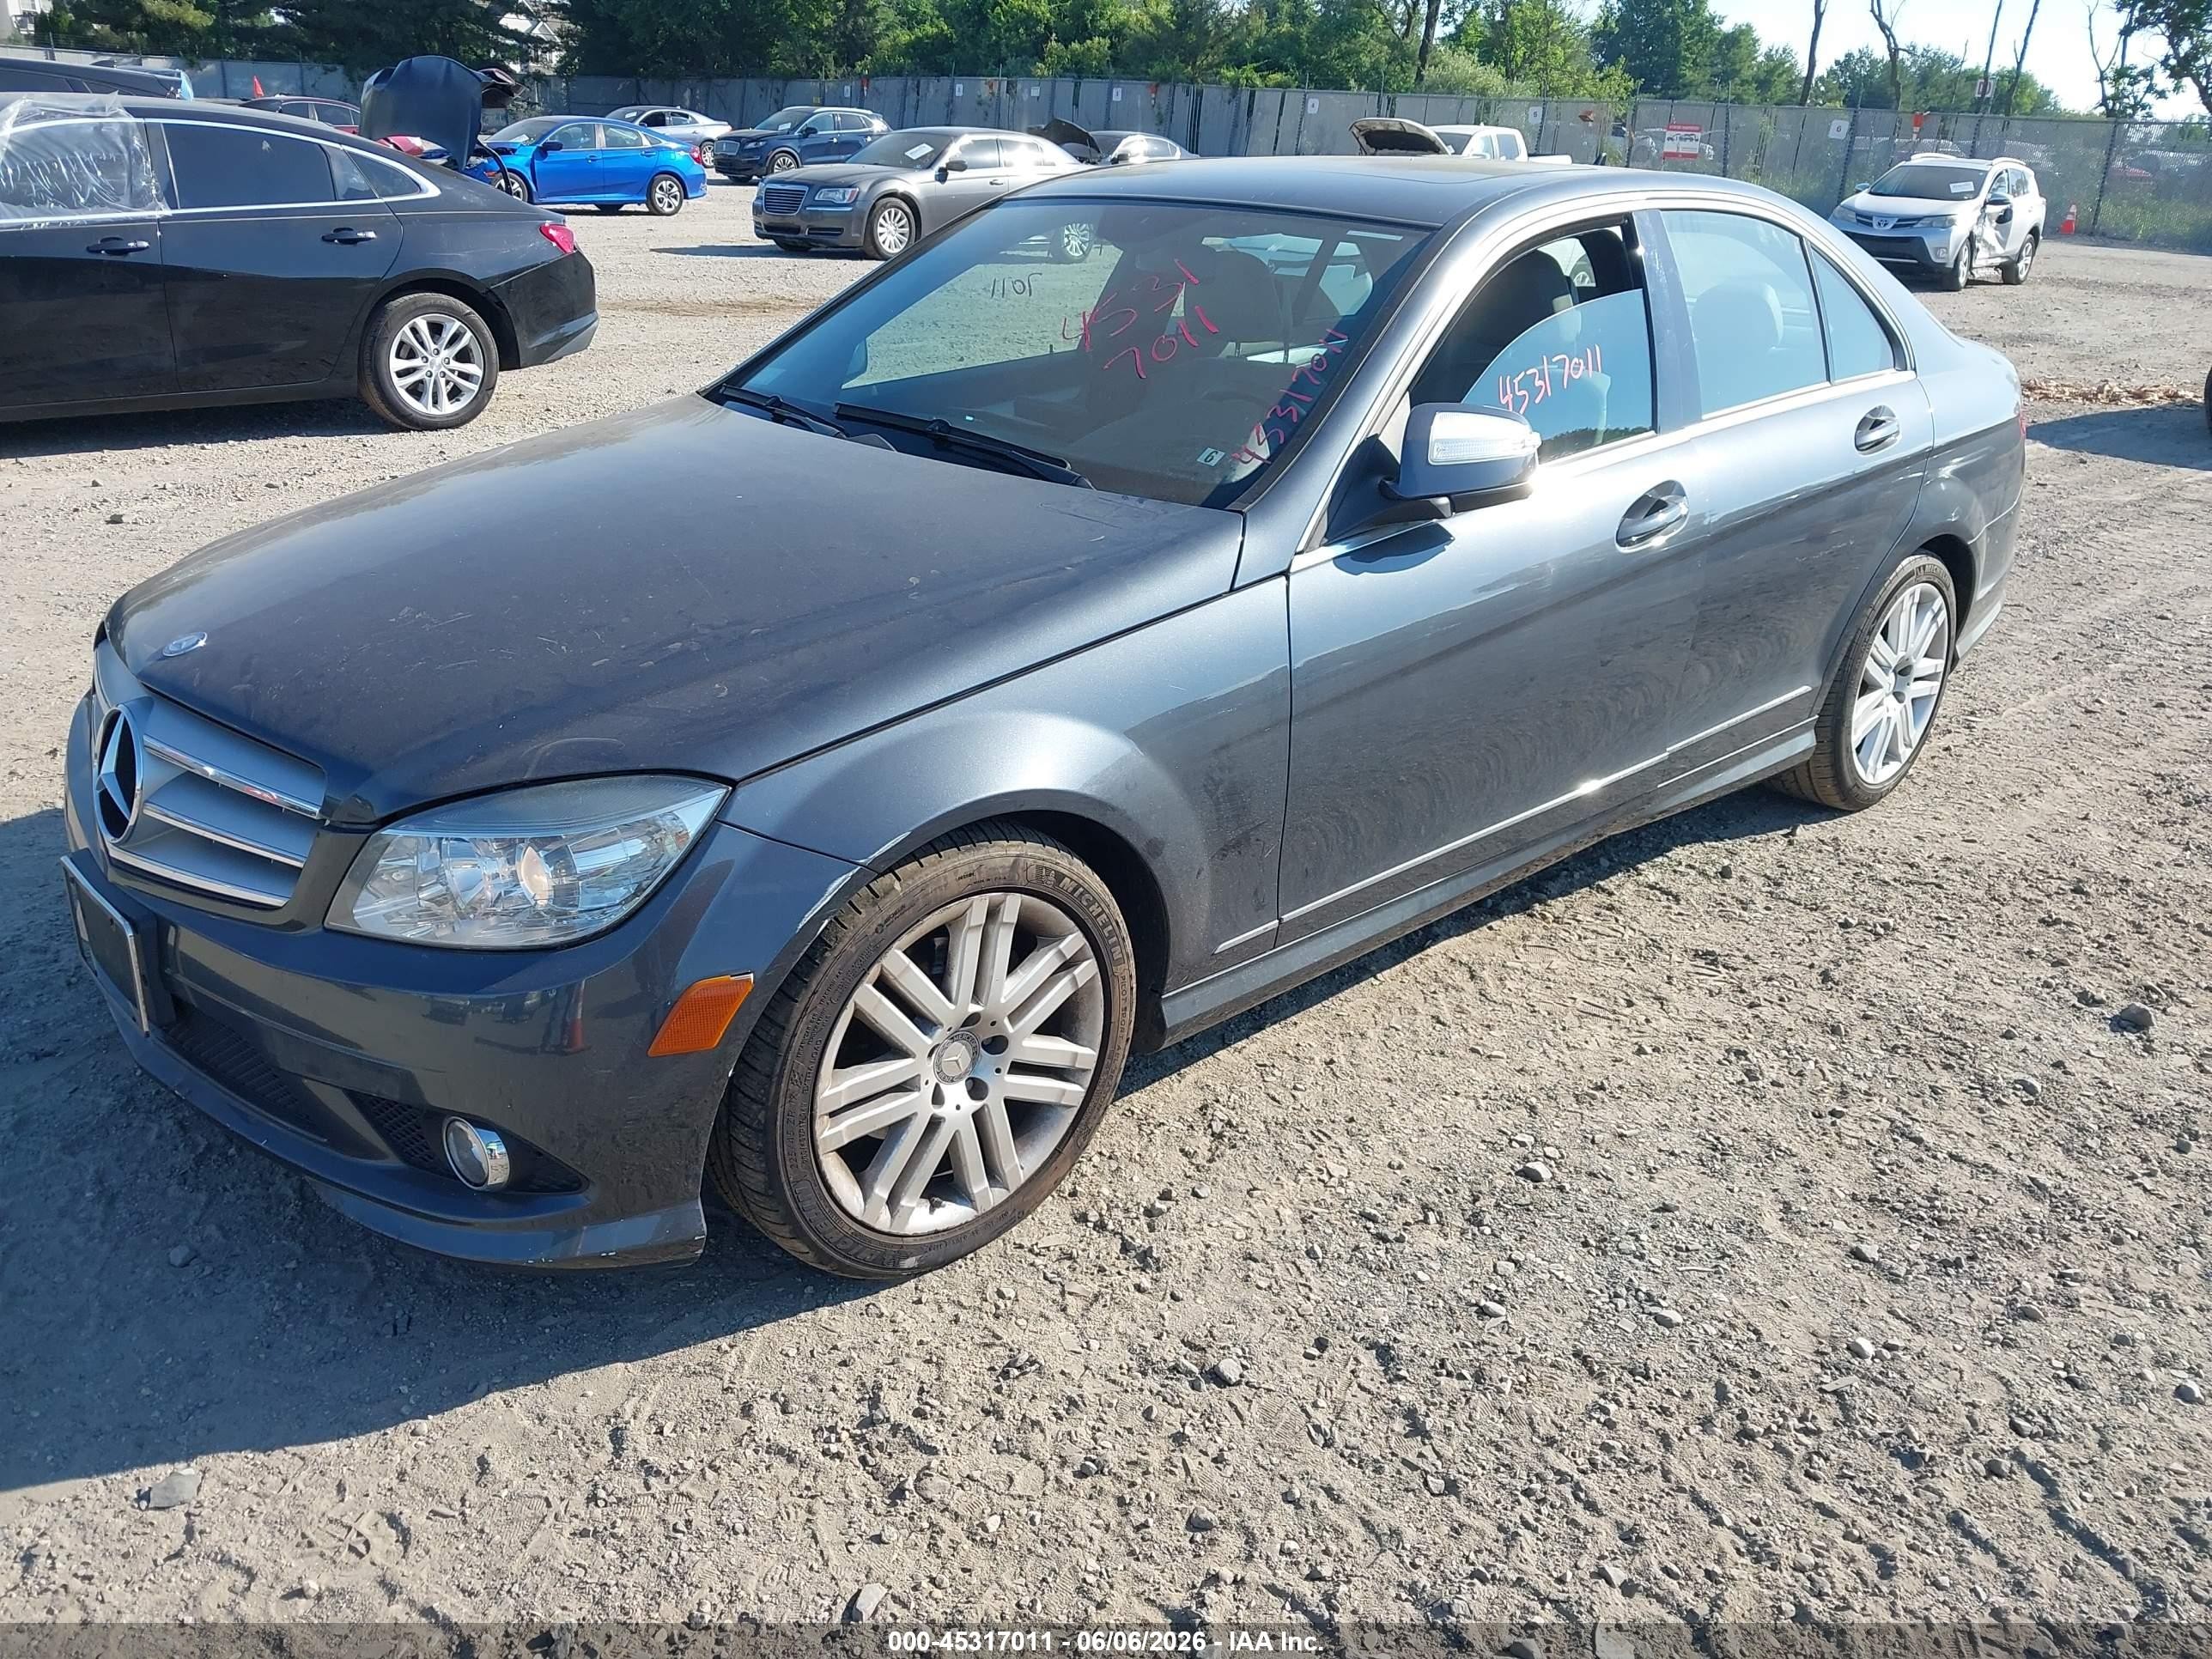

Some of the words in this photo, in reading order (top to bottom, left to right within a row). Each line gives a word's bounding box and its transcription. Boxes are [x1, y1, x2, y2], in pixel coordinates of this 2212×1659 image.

[1062, 258, 1200, 352] 4531
[1102, 306, 1220, 380] 7011
[1498, 343, 1601, 415] 45317011
[1204, 450, 1218, 463] 6
[1059, 877, 1126, 967] MICHELIN
